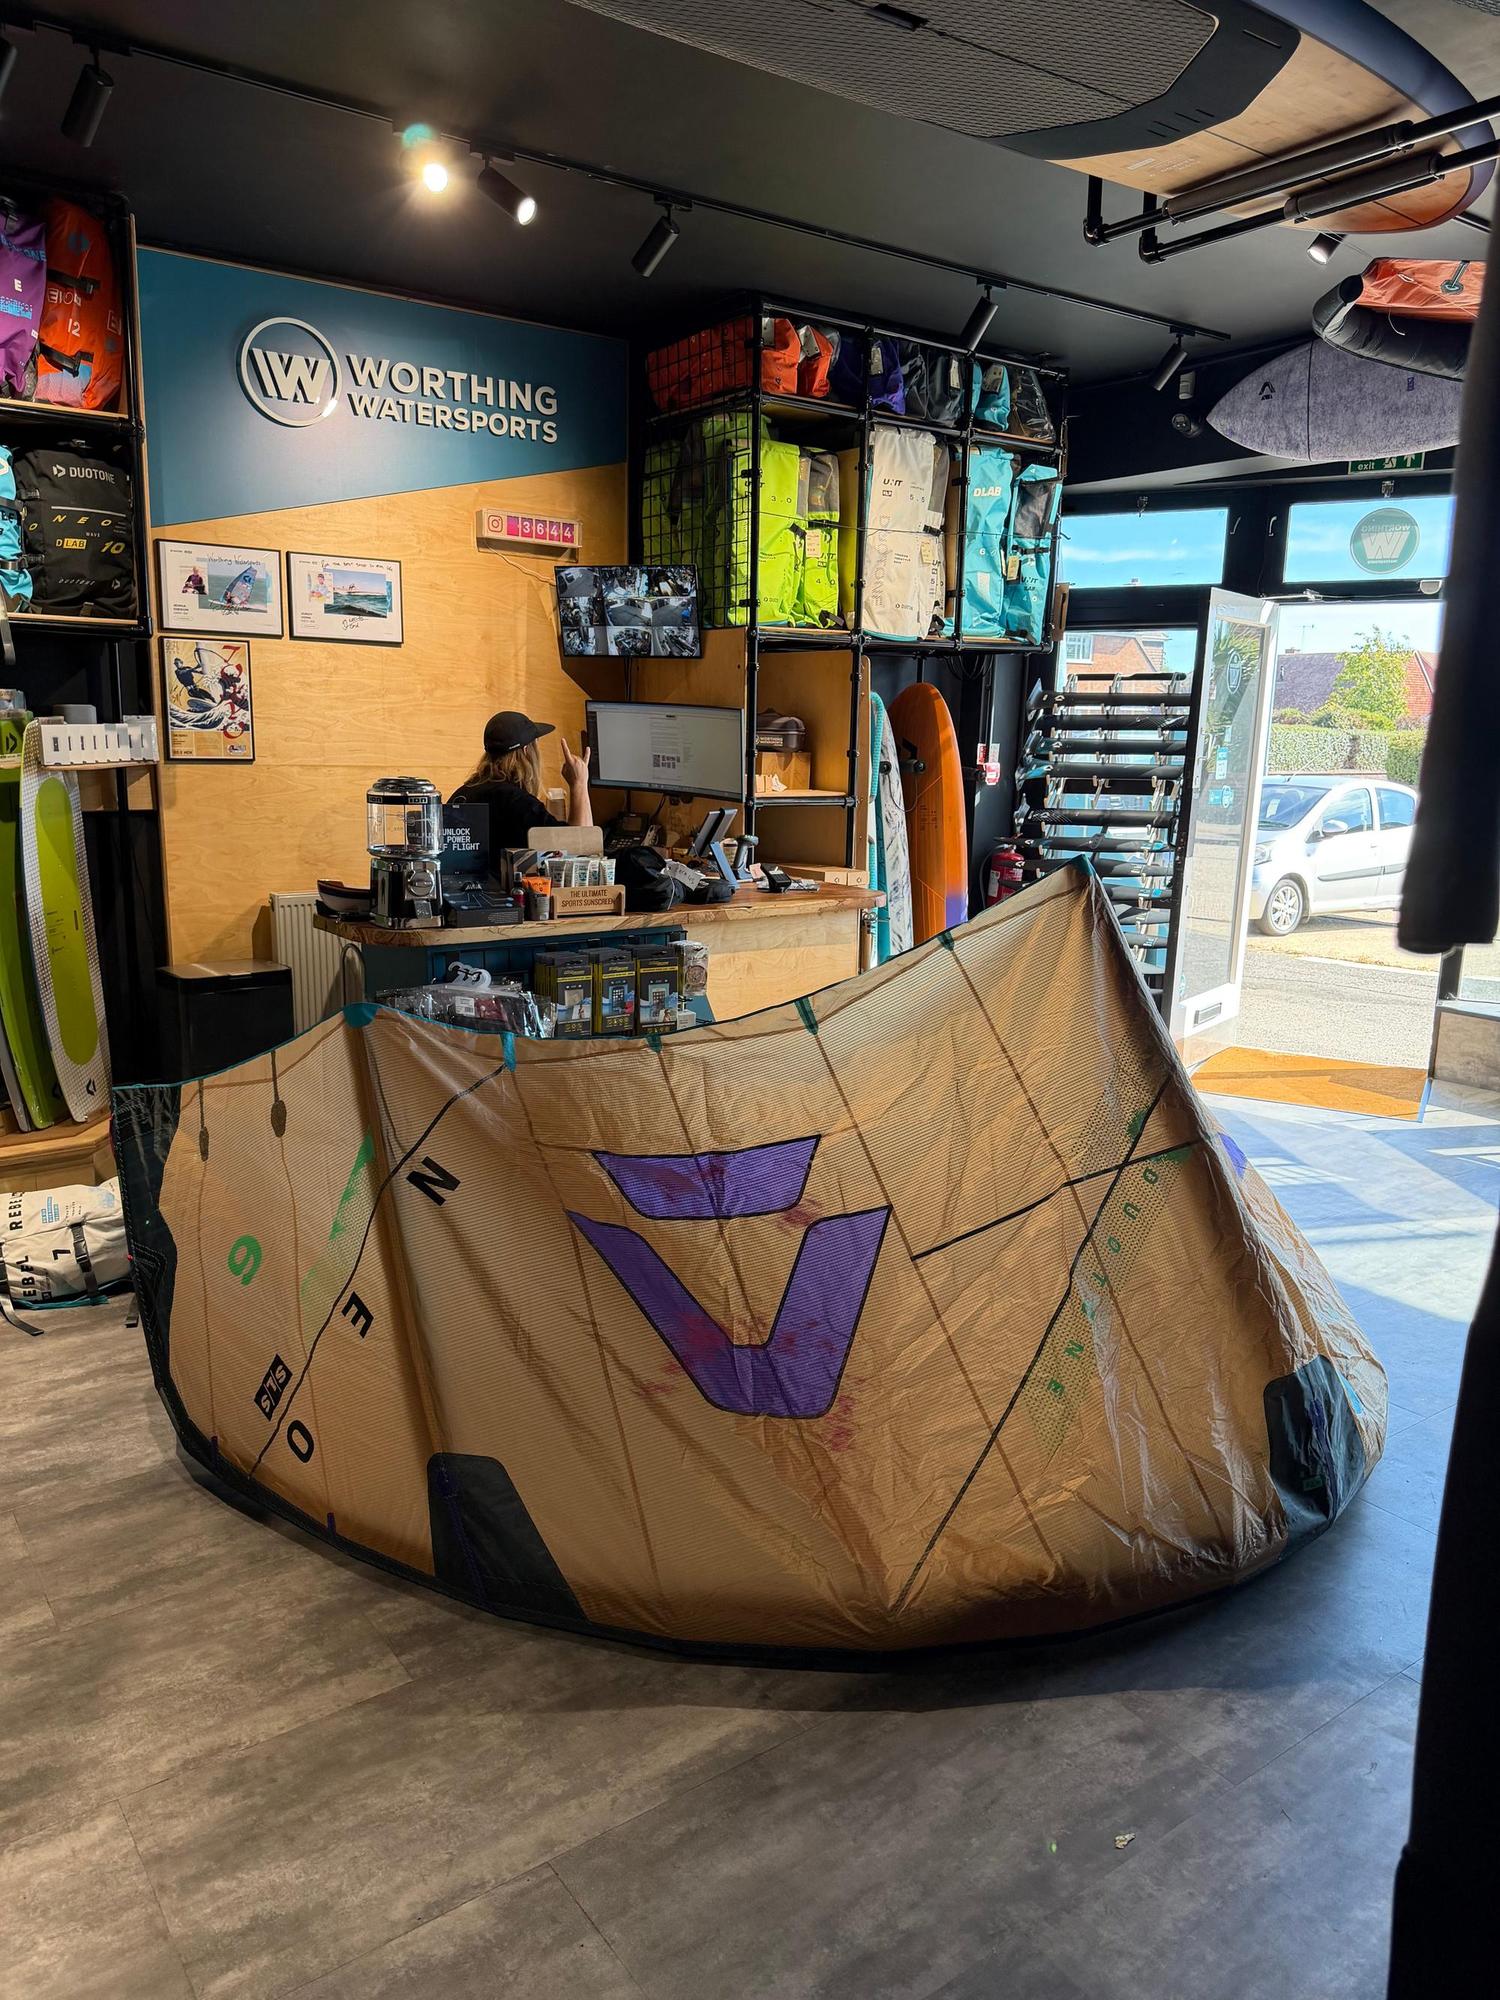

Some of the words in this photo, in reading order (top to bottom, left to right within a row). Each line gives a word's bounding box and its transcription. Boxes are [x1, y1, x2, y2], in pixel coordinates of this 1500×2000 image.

[68, 318, 81, 338] 12
[347, 353, 559, 416] WORTHING
[348, 391, 558, 444] WATERSPORTS
[1357, 462, 1375, 471] exit
[69, 466, 116, 484] DUOTONE
[973, 487, 1002, 497] DLAB
[52, 514, 113, 527] NEO
[522, 520, 573, 540] 3644
[101, 541, 126, 554] 10
[442, 828, 471, 836] UNLOCK
[447, 835, 471, 843] POWER
[452, 842, 481, 851] FLIGHT
[570, 890, 580, 898] THE
[581, 889, 608, 898] ULTIMATE
[561, 899, 583, 907] SPORTS
[583, 897, 616, 907] SUNSCREEN
[286, 1156, 461, 1464] NEO
